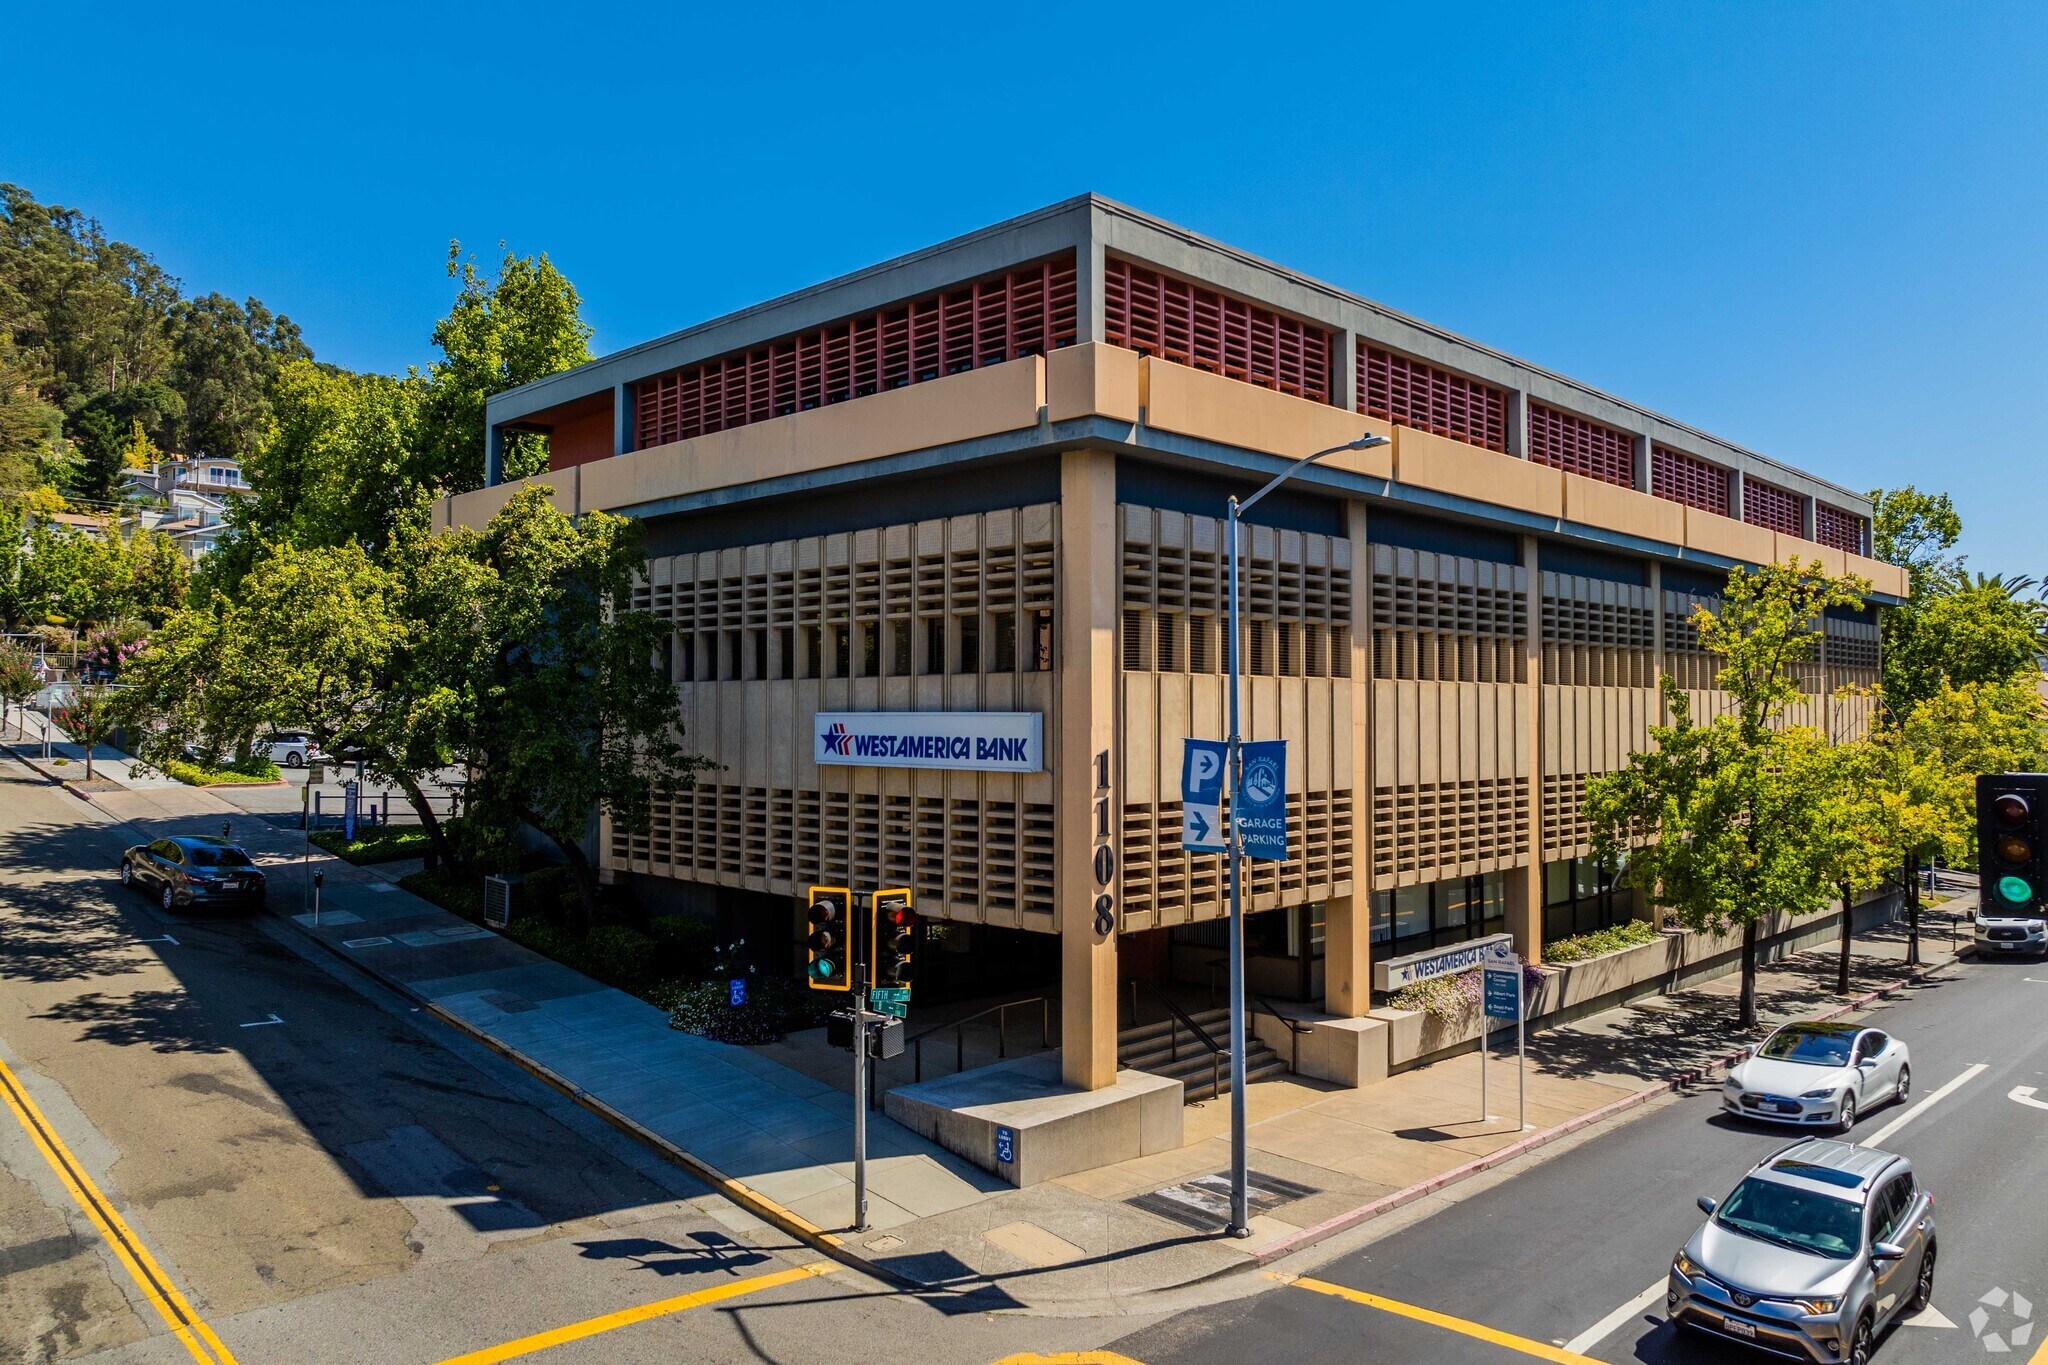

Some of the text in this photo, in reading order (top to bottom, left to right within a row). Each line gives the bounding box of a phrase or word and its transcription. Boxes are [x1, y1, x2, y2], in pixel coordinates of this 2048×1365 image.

[855, 735, 1028, 762] WESTAMERICA BANK
[1190, 749, 1220, 793] P
[1239, 817, 1282, 829] GARAGE
[1095, 749, 1114, 936] 1108
[1241, 833, 1285, 846] PARKING
[1414, 949, 1477, 979] WESTAMERICA
[872, 990, 888, 1000] FIFTH
